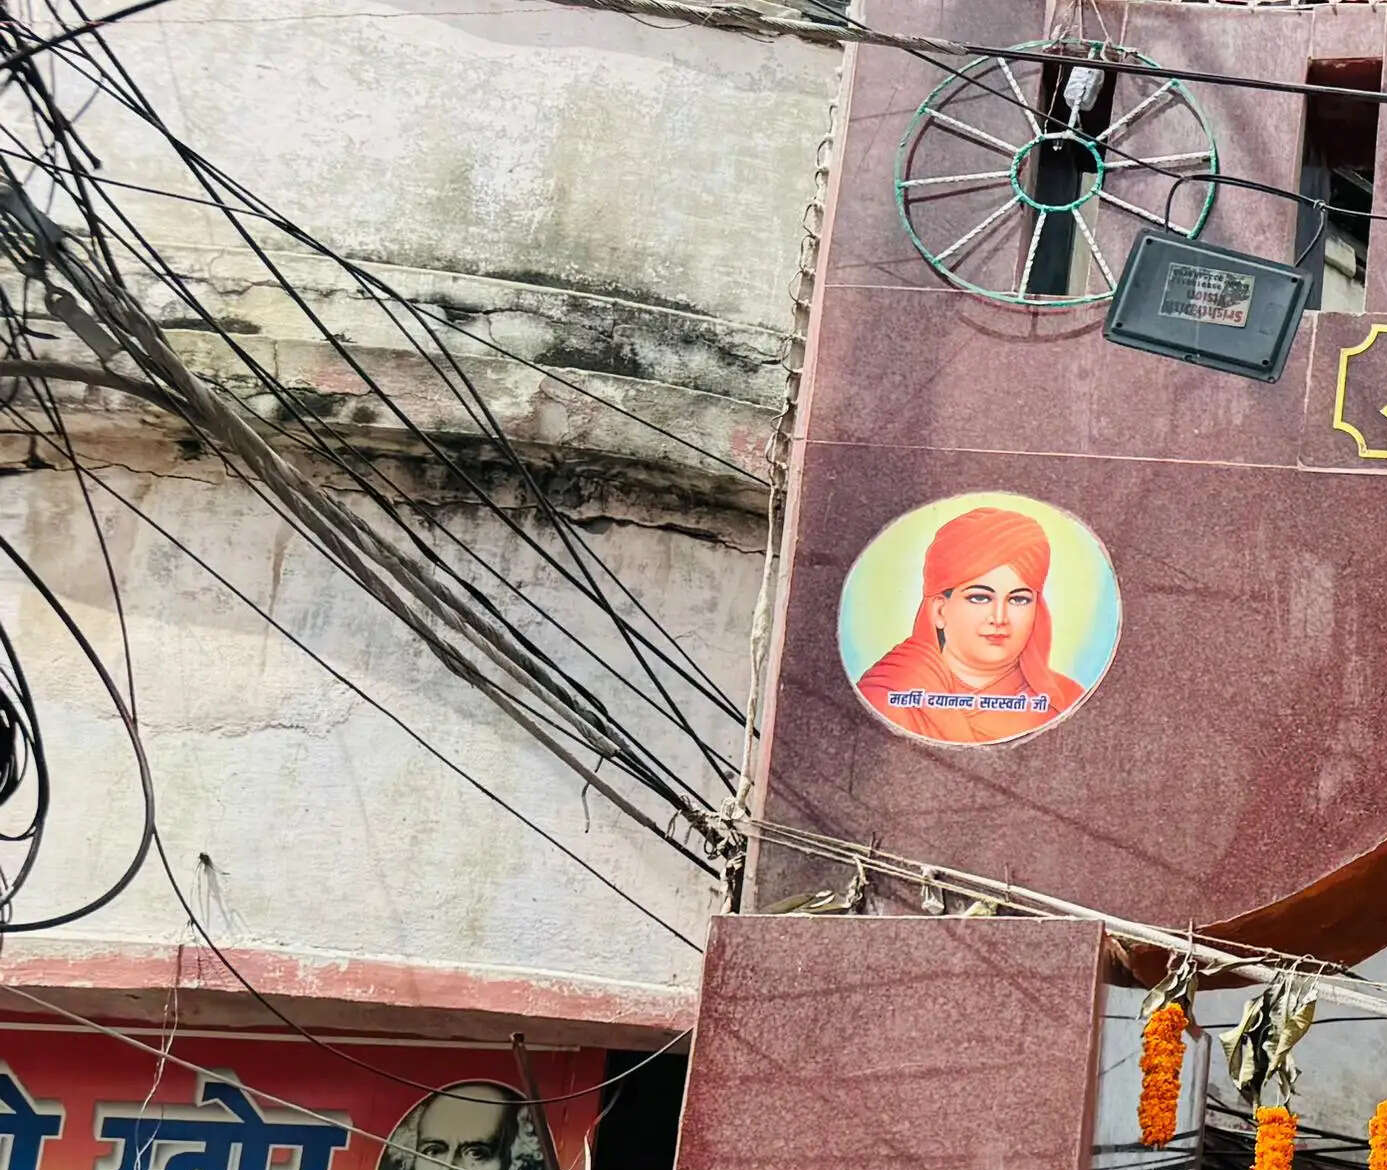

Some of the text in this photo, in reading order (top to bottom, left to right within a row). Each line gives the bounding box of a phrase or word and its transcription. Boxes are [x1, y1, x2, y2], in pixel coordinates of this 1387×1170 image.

[889, 690, 921, 708] महर्षि
[980, 693, 1026, 711] सरस्वती
[1031, 695, 1048, 712] जी
